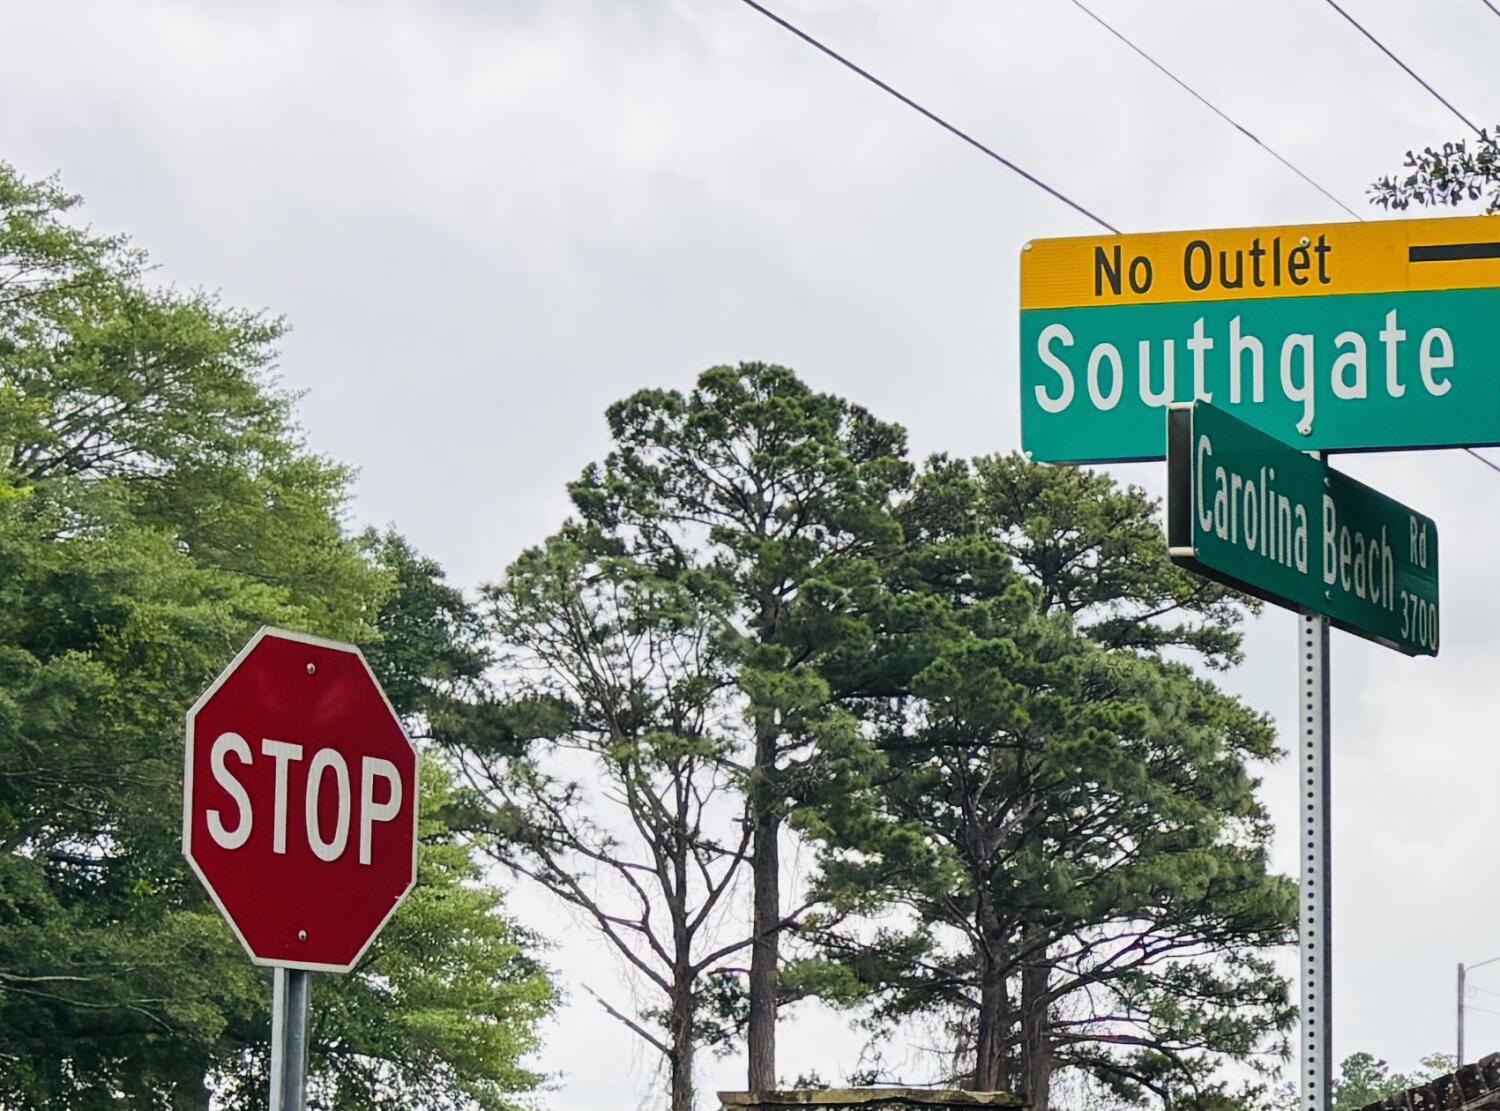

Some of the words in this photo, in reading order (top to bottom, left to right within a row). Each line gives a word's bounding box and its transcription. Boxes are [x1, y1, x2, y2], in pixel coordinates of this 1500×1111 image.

[1094, 246, 1153, 296] No
[1184, 235, 1333, 291] Outlet
[1034, 308, 1455, 436] Southgate
[1197, 434, 1308, 574] Carolina
[1322, 494, 1394, 611] Beach
[1410, 515, 1427, 569] Rd
[1400, 591, 1438, 650] 3700
[206, 732, 403, 865] STOP
